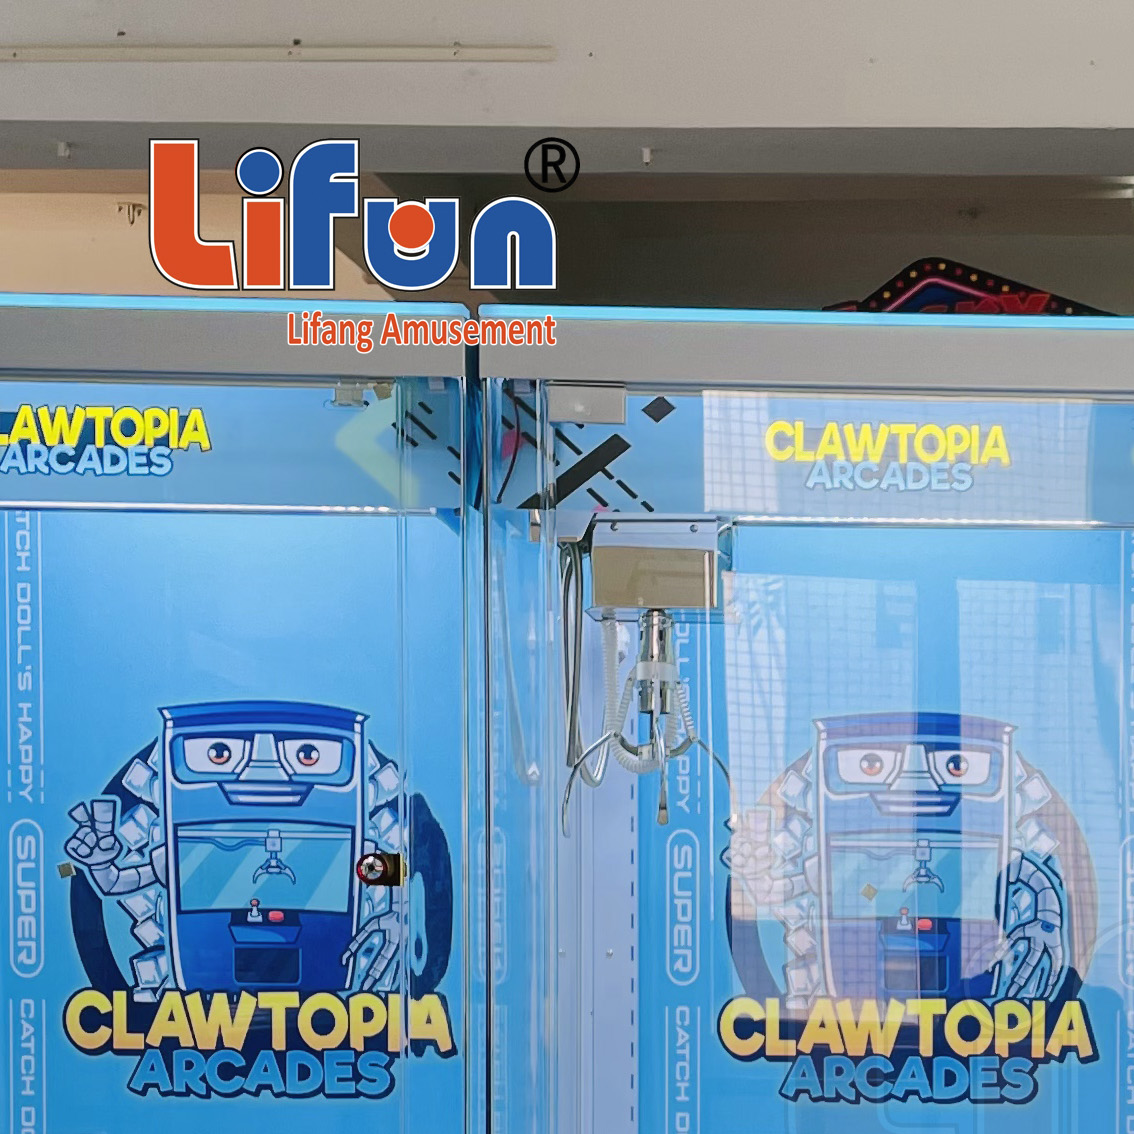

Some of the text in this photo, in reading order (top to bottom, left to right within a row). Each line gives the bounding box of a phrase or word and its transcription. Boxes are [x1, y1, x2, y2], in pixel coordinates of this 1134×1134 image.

[0, 404, 212, 452] AWTOPIA
[0, 442, 173, 477] ARCADES
[764, 419, 1012, 467] CLAWTOPIA
[805, 459, 974, 491] ARCADES
[15, 511, 33, 804] TCH DOLL'S HAPPY
[17, 835, 36, 965] SUPER
[673, 844, 692, 972] SUPER
[20, 998, 35, 1095] CATCH
[64, 988, 455, 1058] CLAWTOPIA
[675, 1005, 690, 1102] CATCH
[718, 997, 1097, 1062] CLAWTOPIA
[128, 1048, 393, 1097] ARCADES
[780, 1053, 1037, 1104] ARCADES
